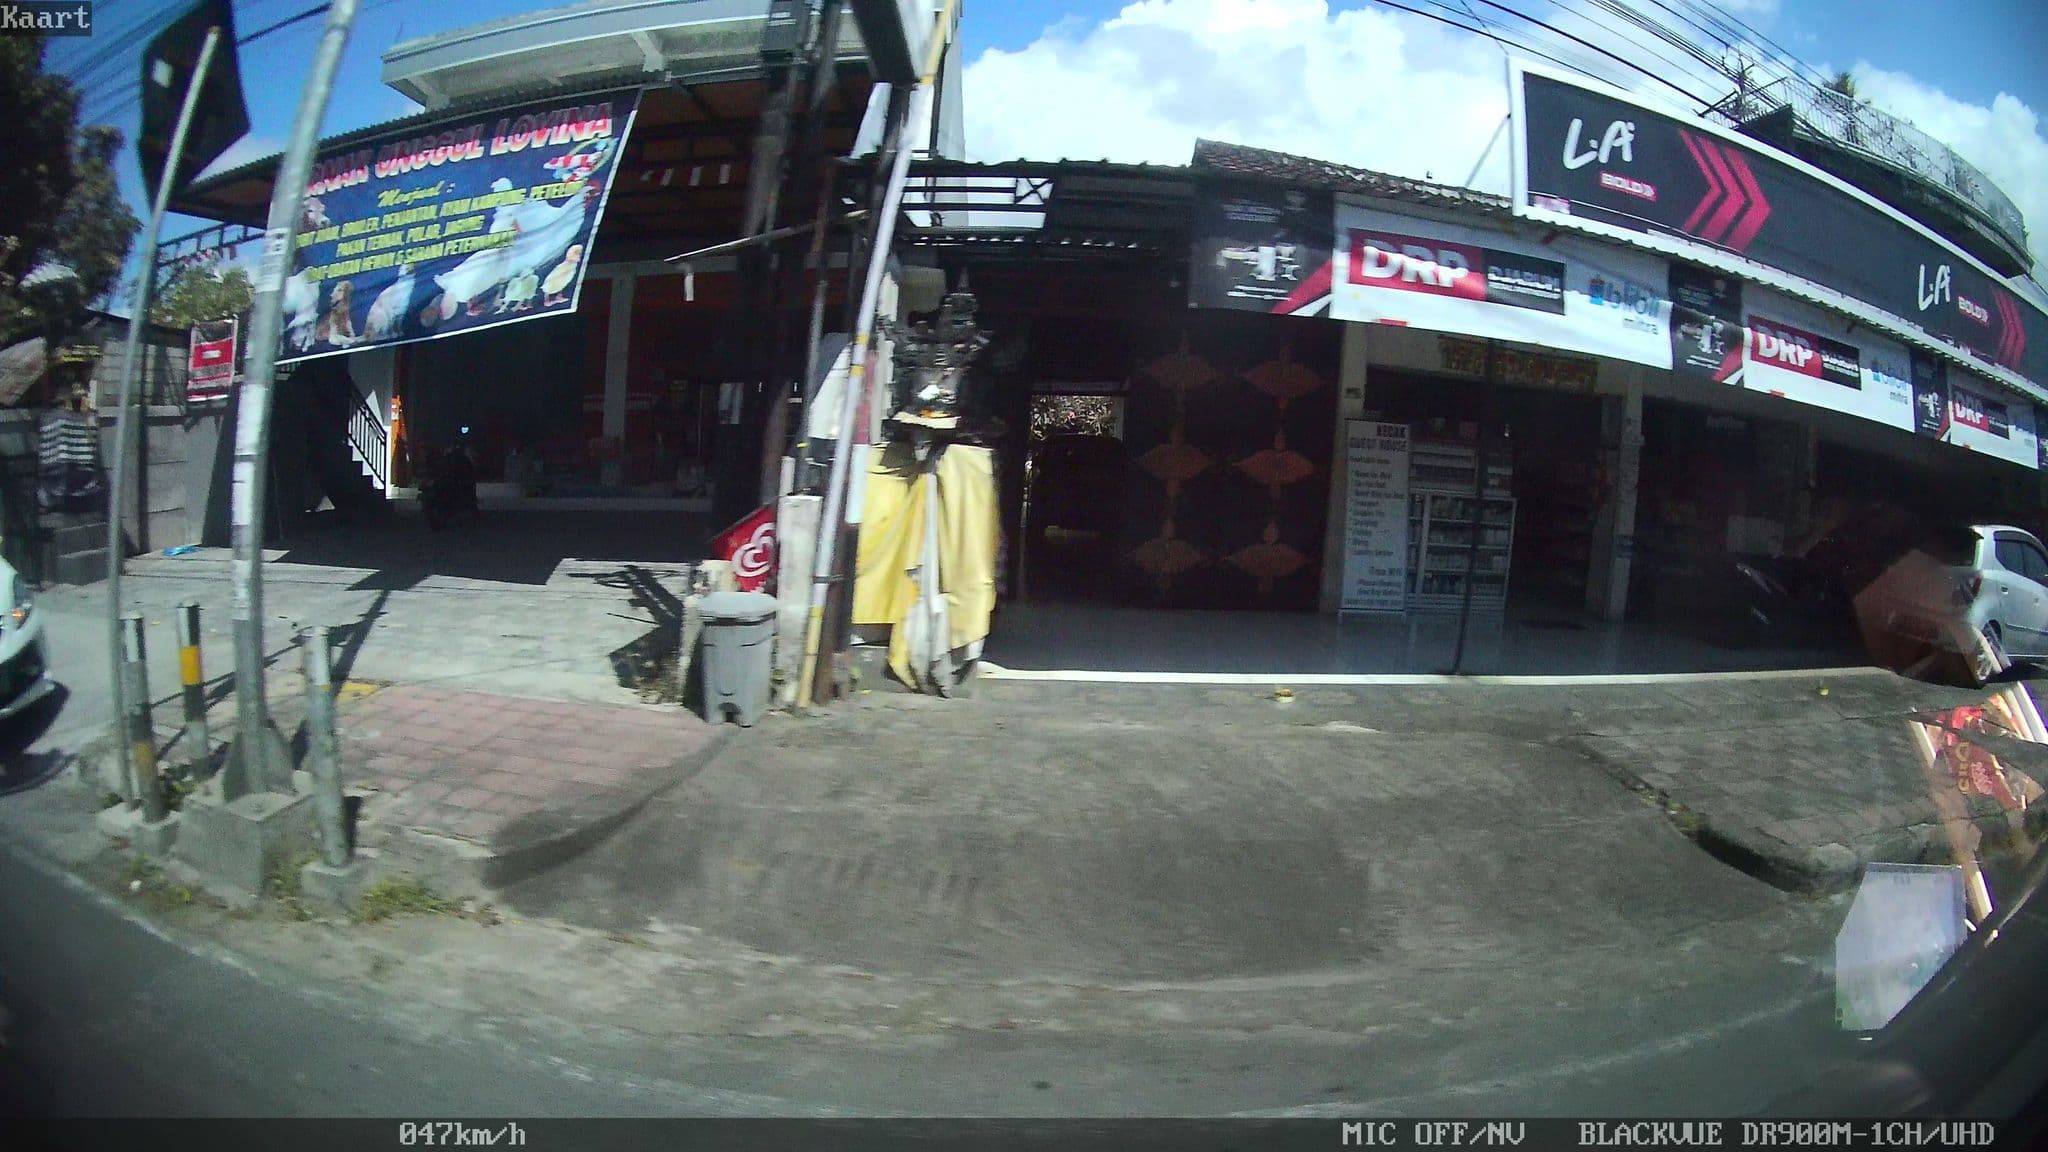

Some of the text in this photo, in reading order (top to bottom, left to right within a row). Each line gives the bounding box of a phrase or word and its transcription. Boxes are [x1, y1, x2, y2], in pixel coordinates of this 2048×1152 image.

[375, 123, 484, 179] UNGGUL
[489, 102, 613, 156] LOVINA
[1361, 238, 1470, 289] DRP
[1754, 324, 1814, 368] DRP
